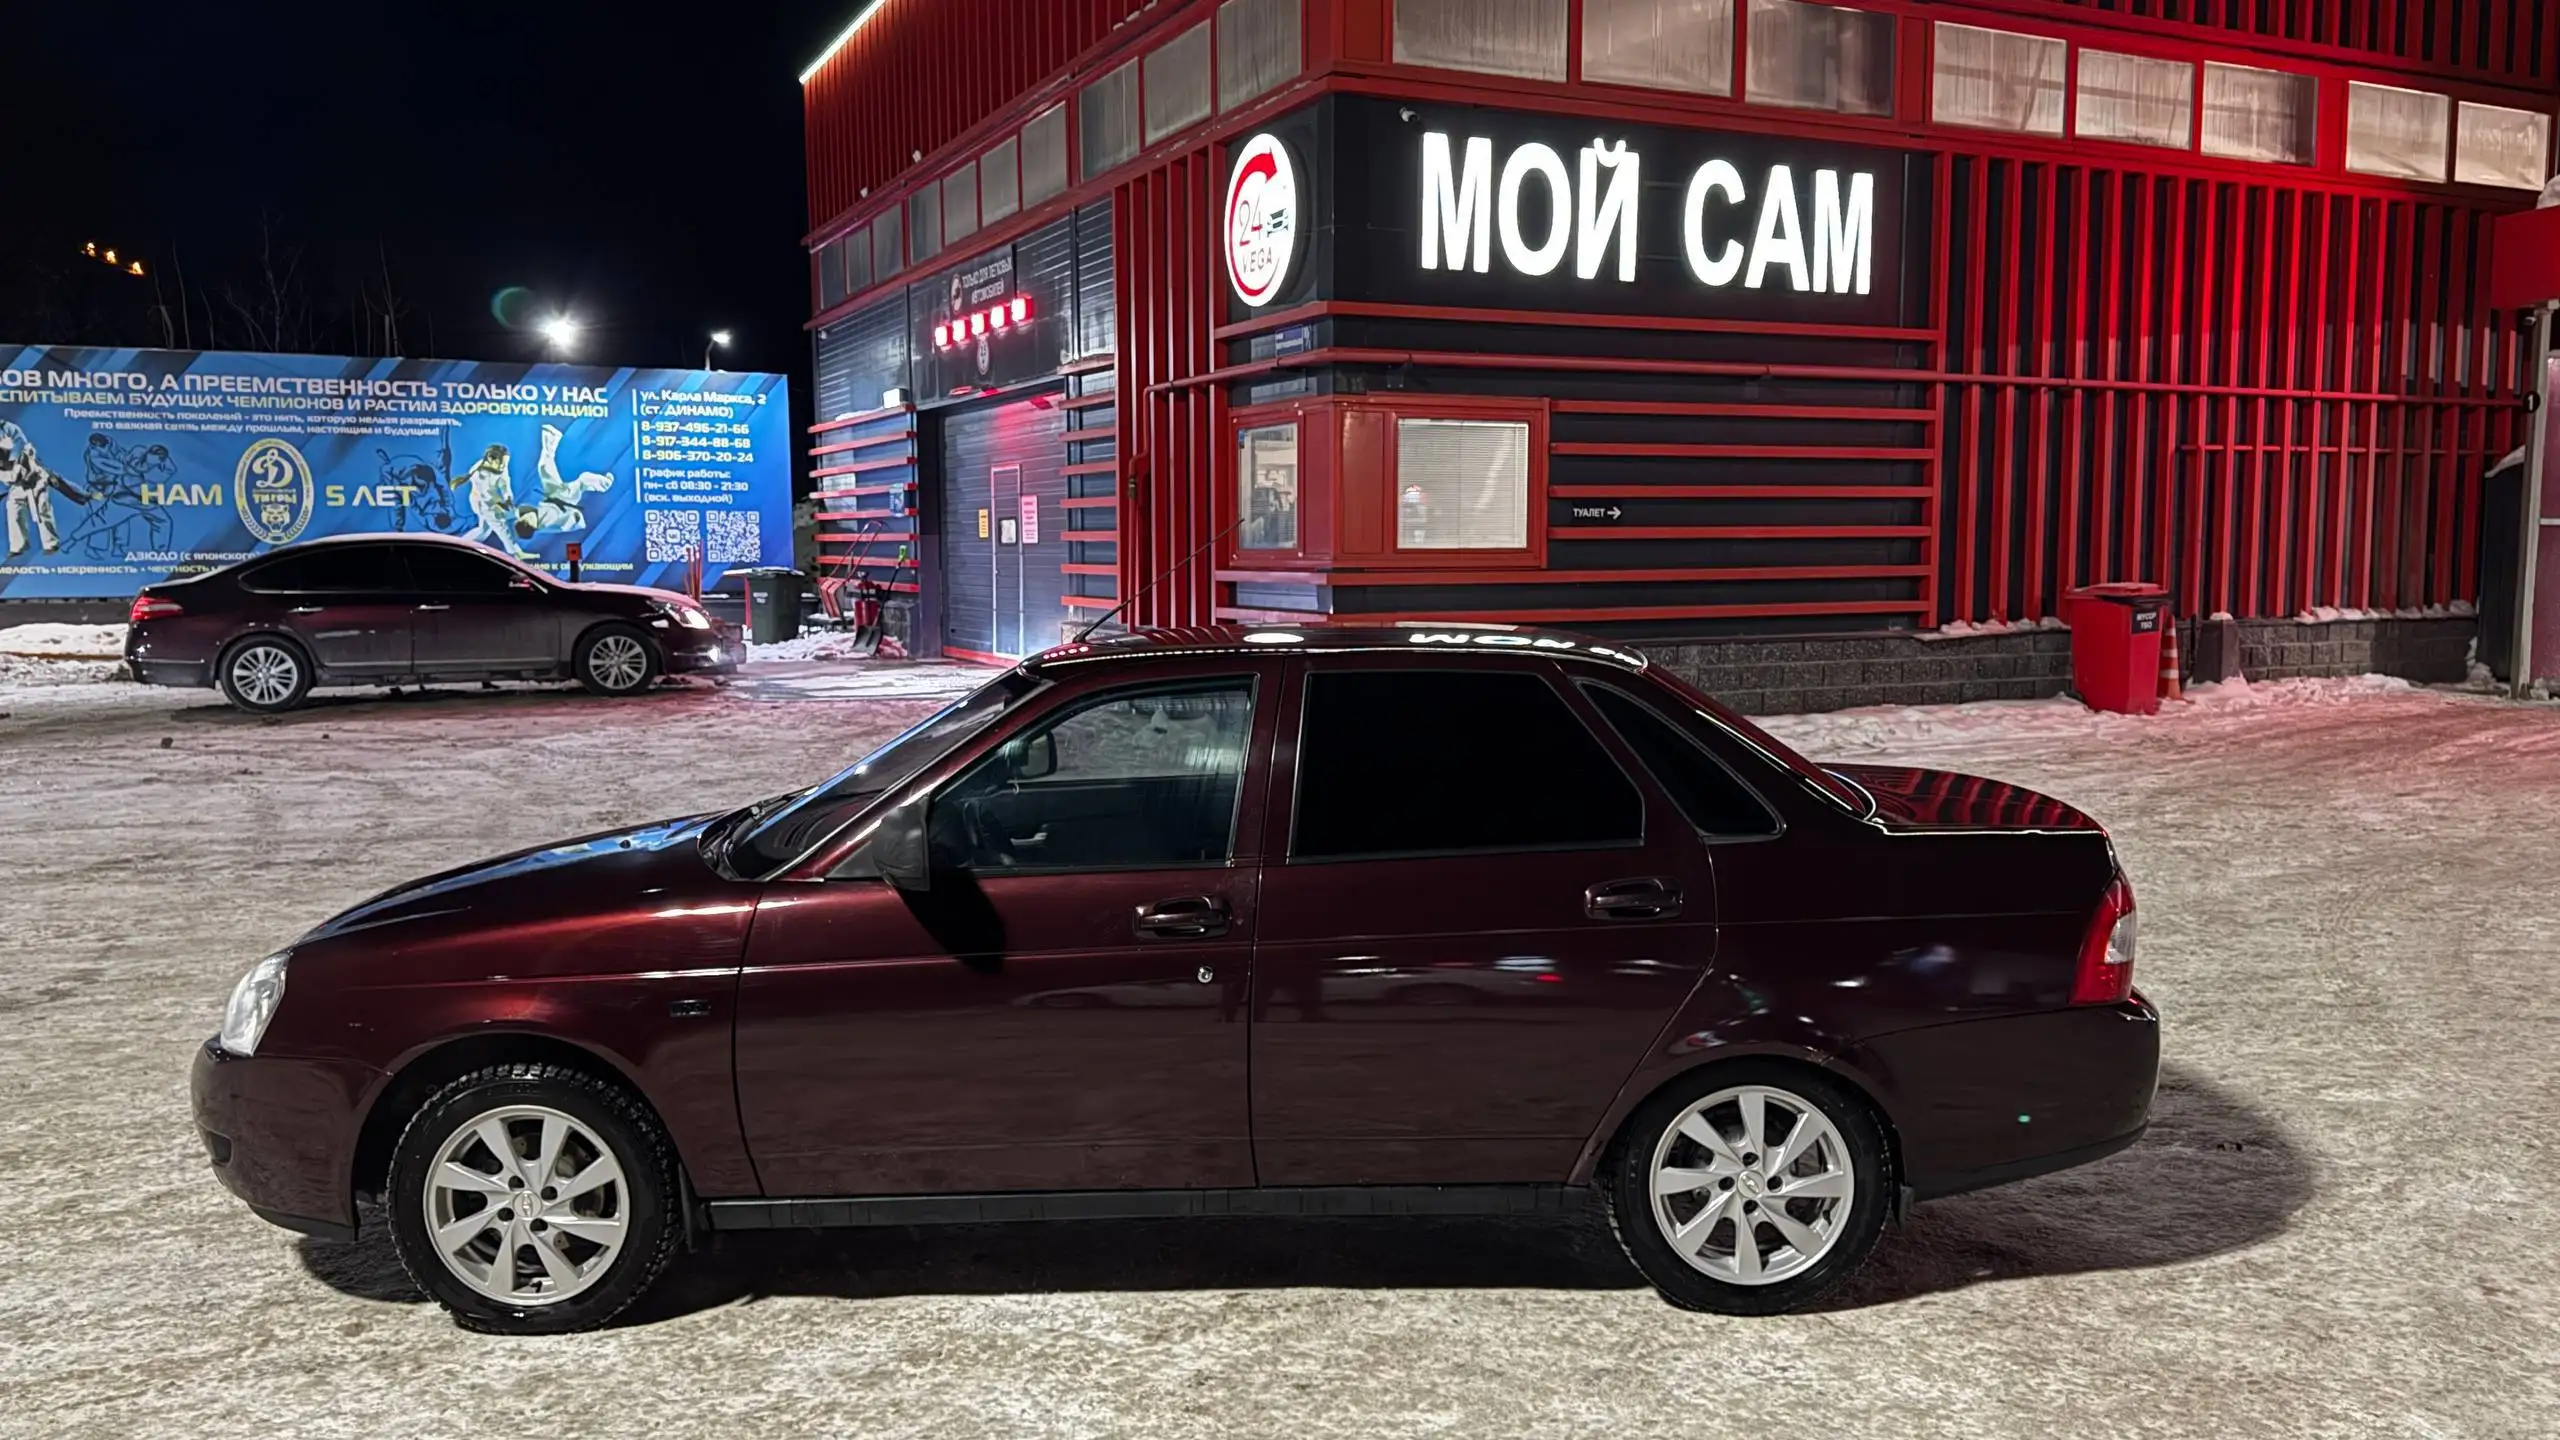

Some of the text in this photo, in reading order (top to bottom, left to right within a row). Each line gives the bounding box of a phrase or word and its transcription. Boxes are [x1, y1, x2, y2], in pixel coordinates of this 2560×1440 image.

[1421, 131, 1874, 295] МОЙ САМ
[1239, 195, 1263, 247] 24
[1242, 247, 1272, 274] VEGA
[0, 369, 608, 403] ОВ МНОГО, А ПРЕЕМСТВЕННОСТЬ ТОЛЬКО У НАС
[640, 390, 767, 405] ул. Карла Маркса, 2
[129, 393, 224, 408] БУДУЩИХ
[226, 395, 343, 409] ЧЕМПИОНОВ
[347, 398, 360, 411] И
[364, 399, 437, 412] РАСТИМ
[440, 401, 539, 415] ЗДОРОВУЮ
[541, 404, 608, 418] НАЦИЮ!
[640, 405, 734, 418] (ст. ДИНАМО)
[64, 408, 174, 420] Преемственность
[177, 411, 242, 421] поколений
[252, 413, 273, 422] это
[307, 415, 356, 425] которую
[358, 416, 398, 425] нельзя
[92, 422, 113, 430] это
[115, 422, 162, 431] важная
[165, 423, 199, 431] связь
[201, 424, 243, 433] между
[307, 426, 372, 435] настоящим
[643, 467, 731, 479] График работы:
[721, 482, 749, 491] 21:30
[141, 484, 417, 507] НАМ 5 ЛЕТ
[672, 494, 733, 504] выходной)
[1573, 507, 1606, 518] ТУАЛЕТ
[125, 551, 177, 561] ДЗЮДО
[57, 565, 138, 575] искренность
[148, 565, 209, 574] честность
